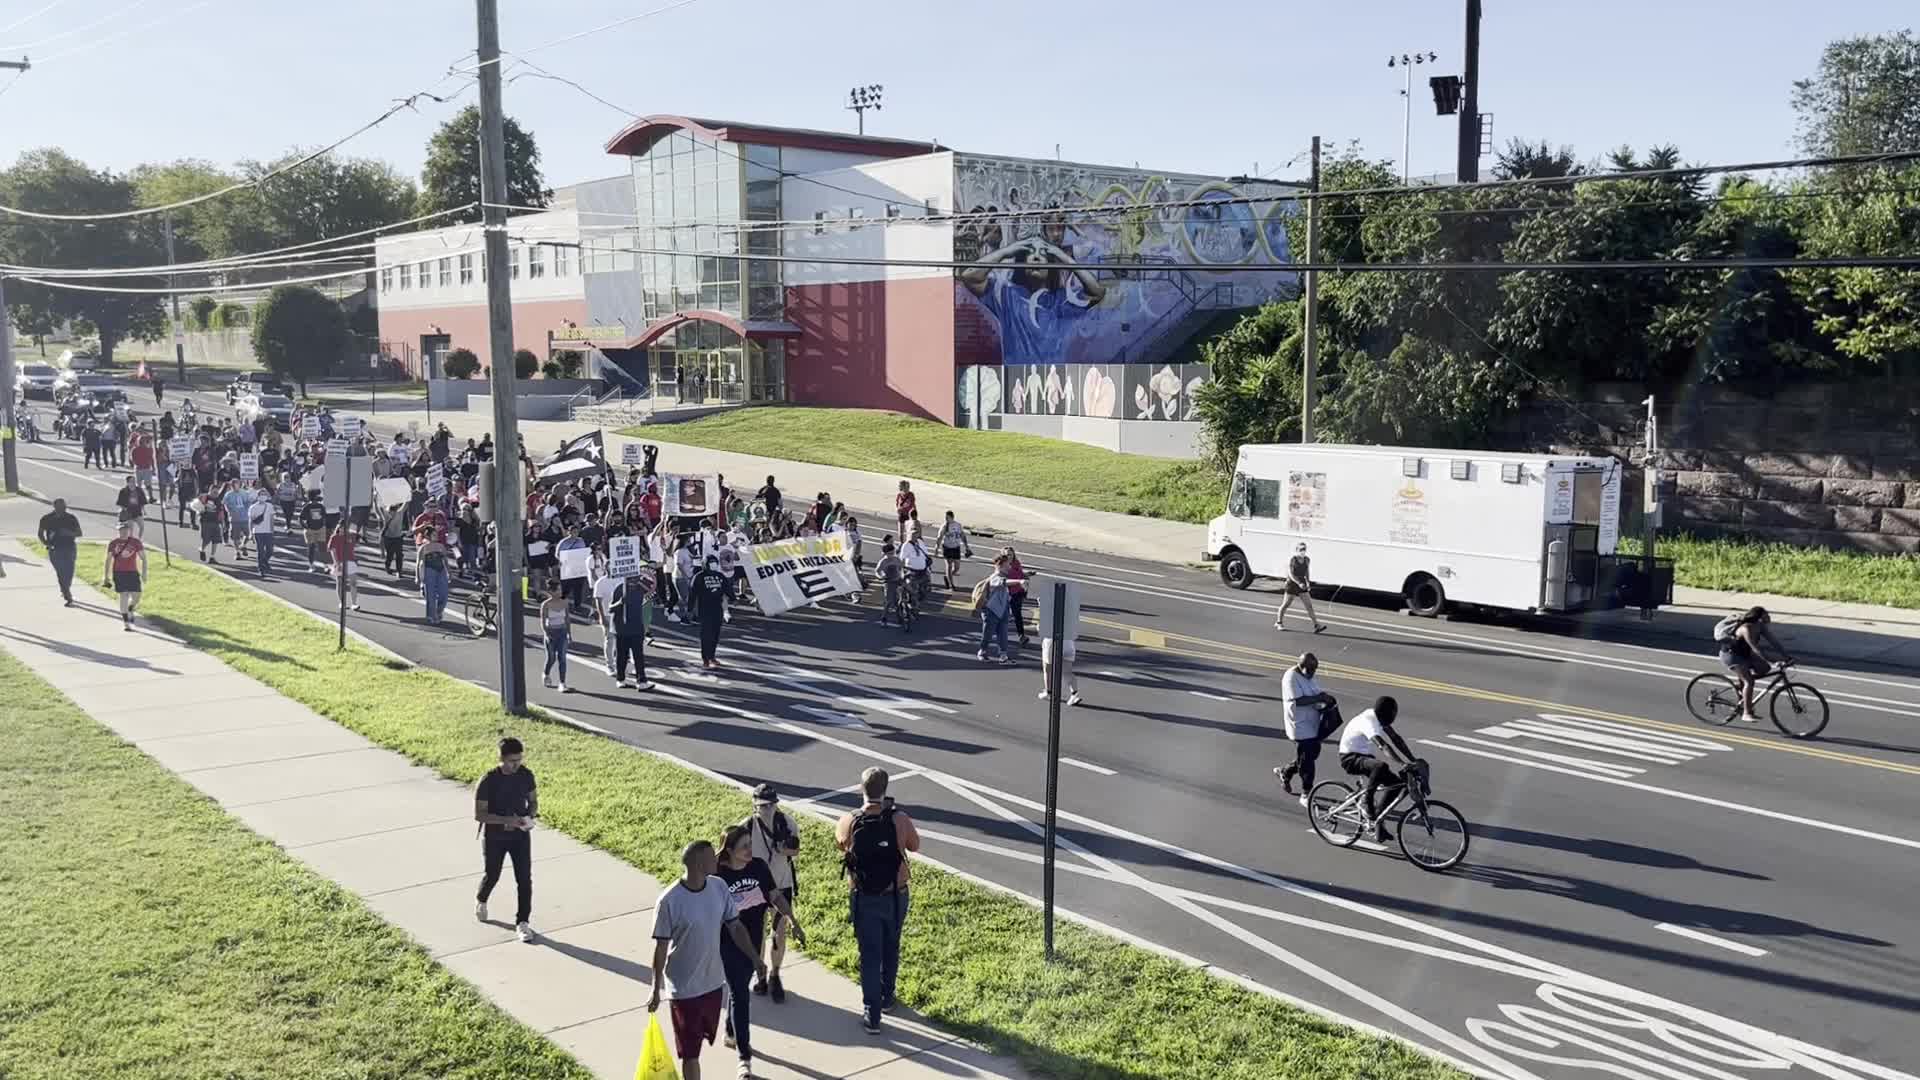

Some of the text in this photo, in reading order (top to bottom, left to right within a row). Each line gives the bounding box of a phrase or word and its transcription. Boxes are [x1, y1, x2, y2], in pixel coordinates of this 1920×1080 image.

[756, 560, 798, 580] EDDIE
[728, 880, 742, 893] OLD
[742, 878, 760, 887] NAVY
